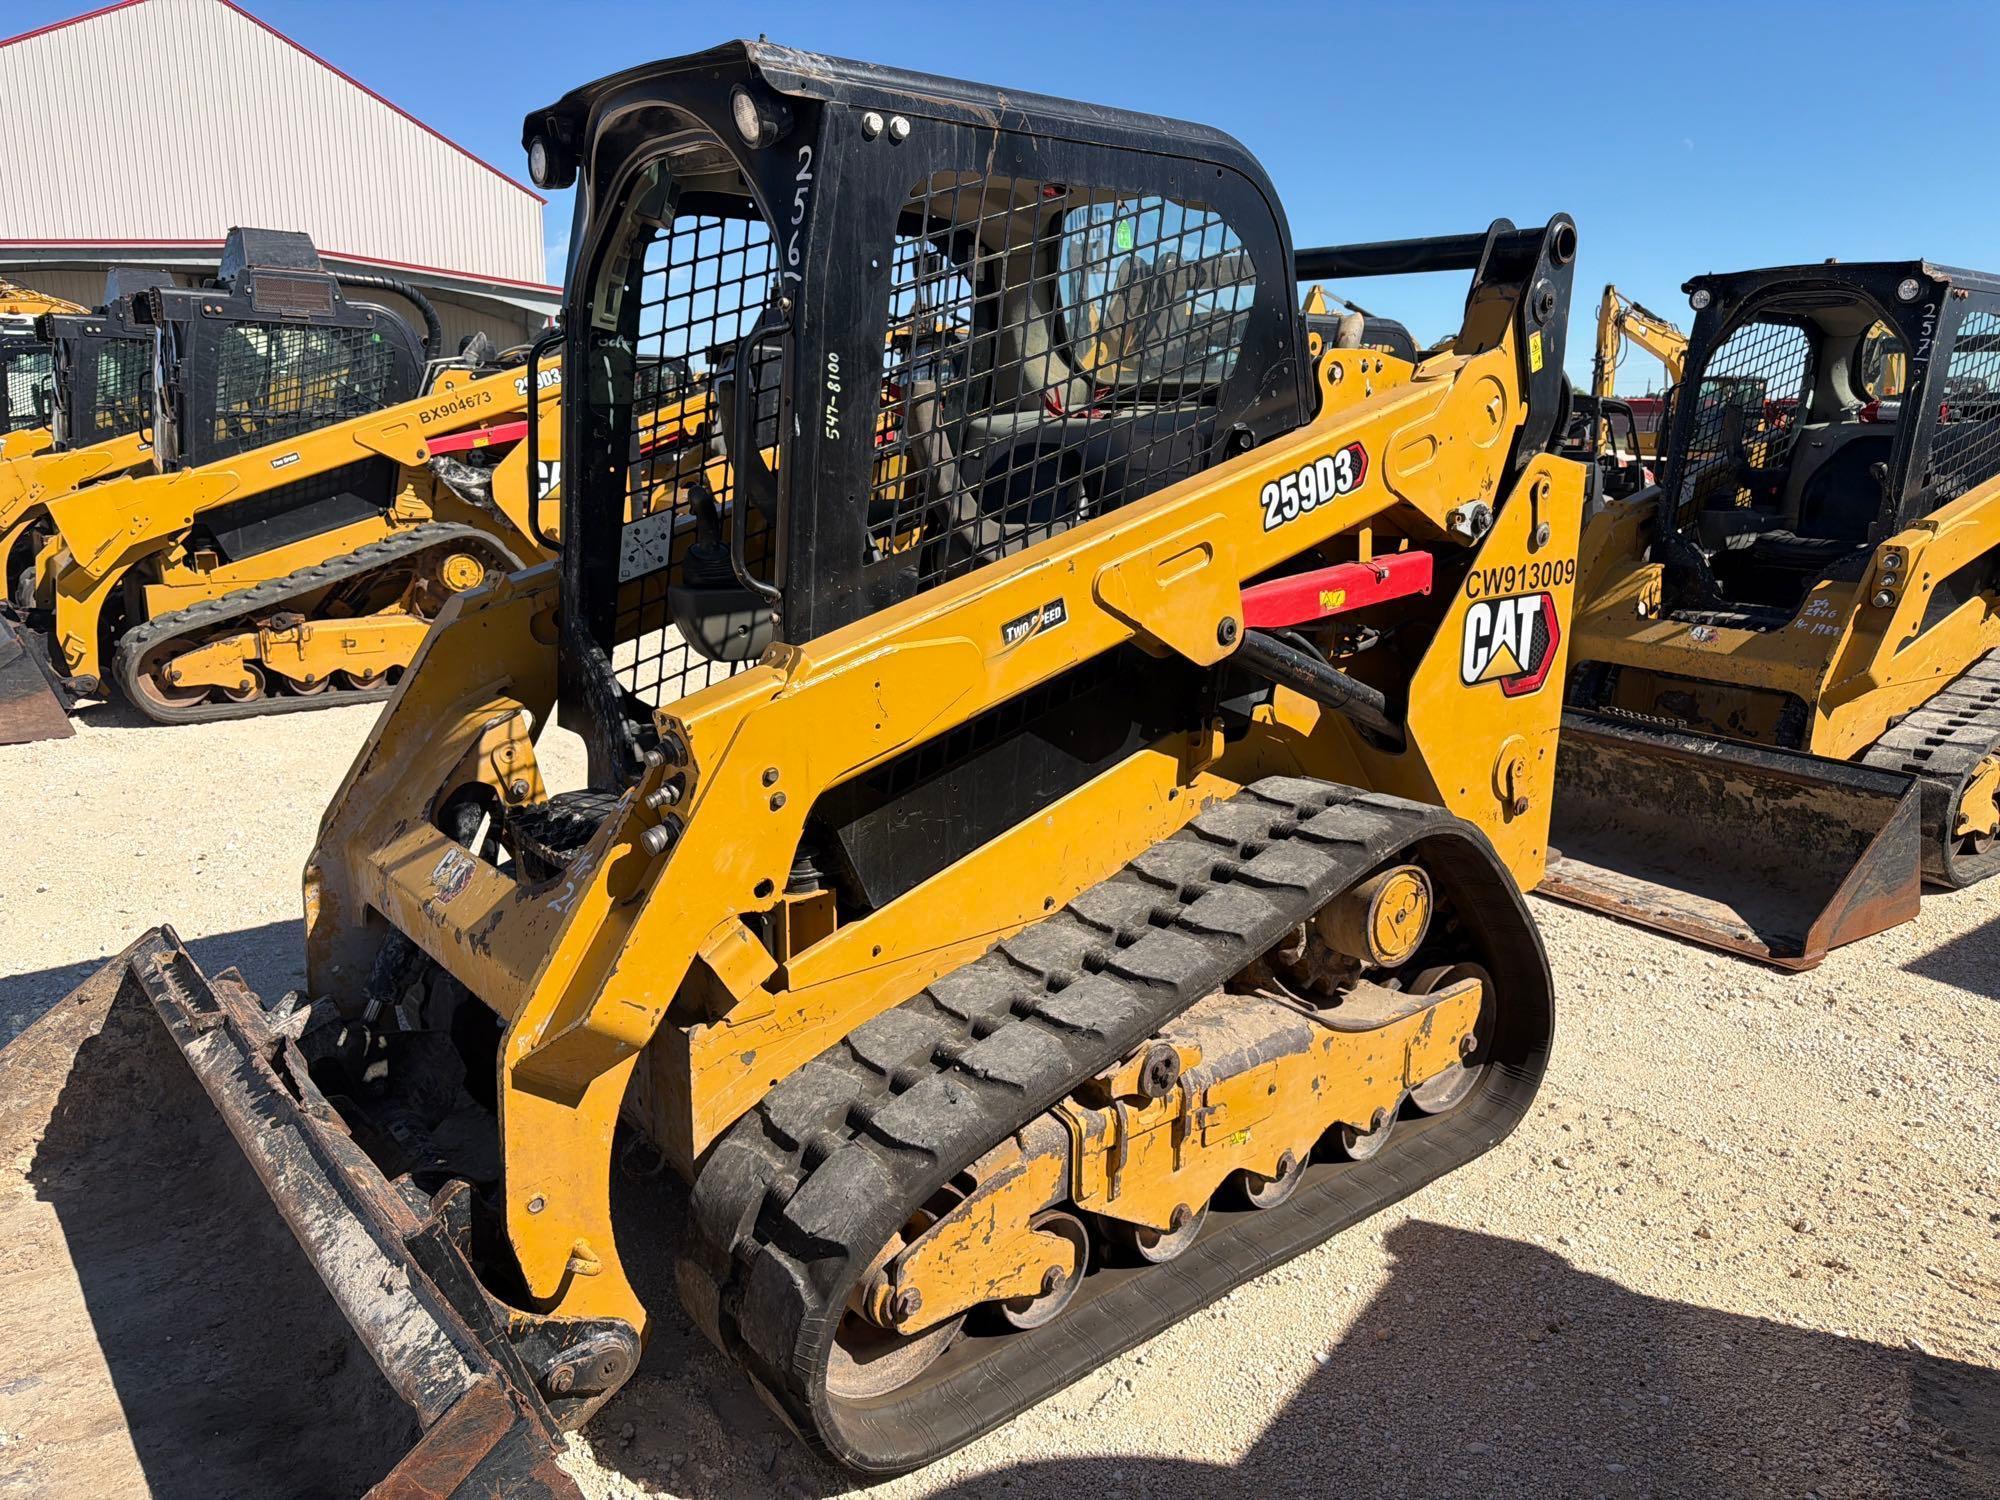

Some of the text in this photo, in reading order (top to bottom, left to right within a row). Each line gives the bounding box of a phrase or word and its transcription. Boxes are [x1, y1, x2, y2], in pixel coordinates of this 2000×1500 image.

[419, 391, 492, 424] BX904673
[825, 351, 842, 440] 547-8100
[1261, 448, 1354, 531] 259D3
[1465, 558, 1576, 599] CW913009
[1462, 594, 1542, 683] CAT
